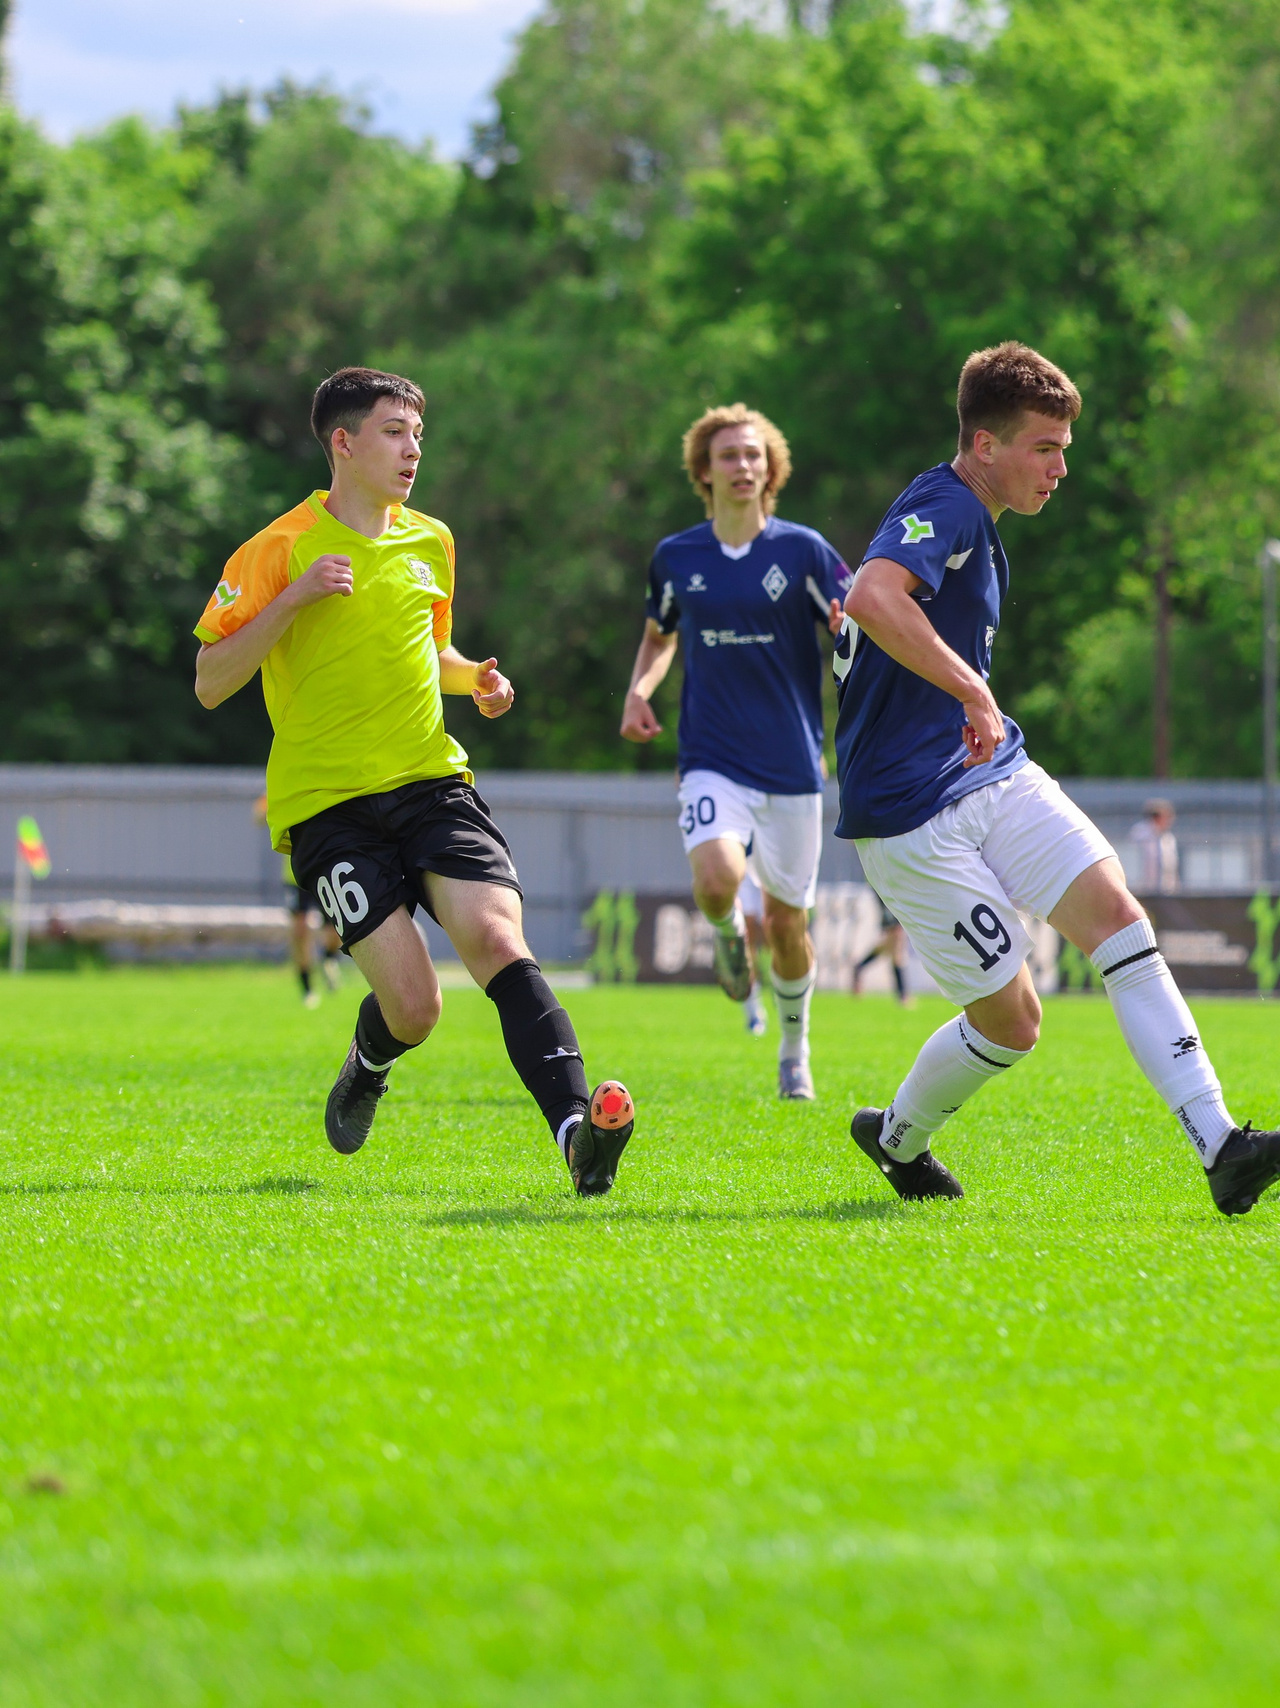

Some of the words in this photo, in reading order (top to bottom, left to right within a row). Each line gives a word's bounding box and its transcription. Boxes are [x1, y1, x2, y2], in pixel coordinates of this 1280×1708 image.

[683, 796, 716, 835] 30
[317, 861, 369, 937] 96
[953, 903, 1012, 972] 19
[1176, 1105, 1202, 1141] FOOTBALL
